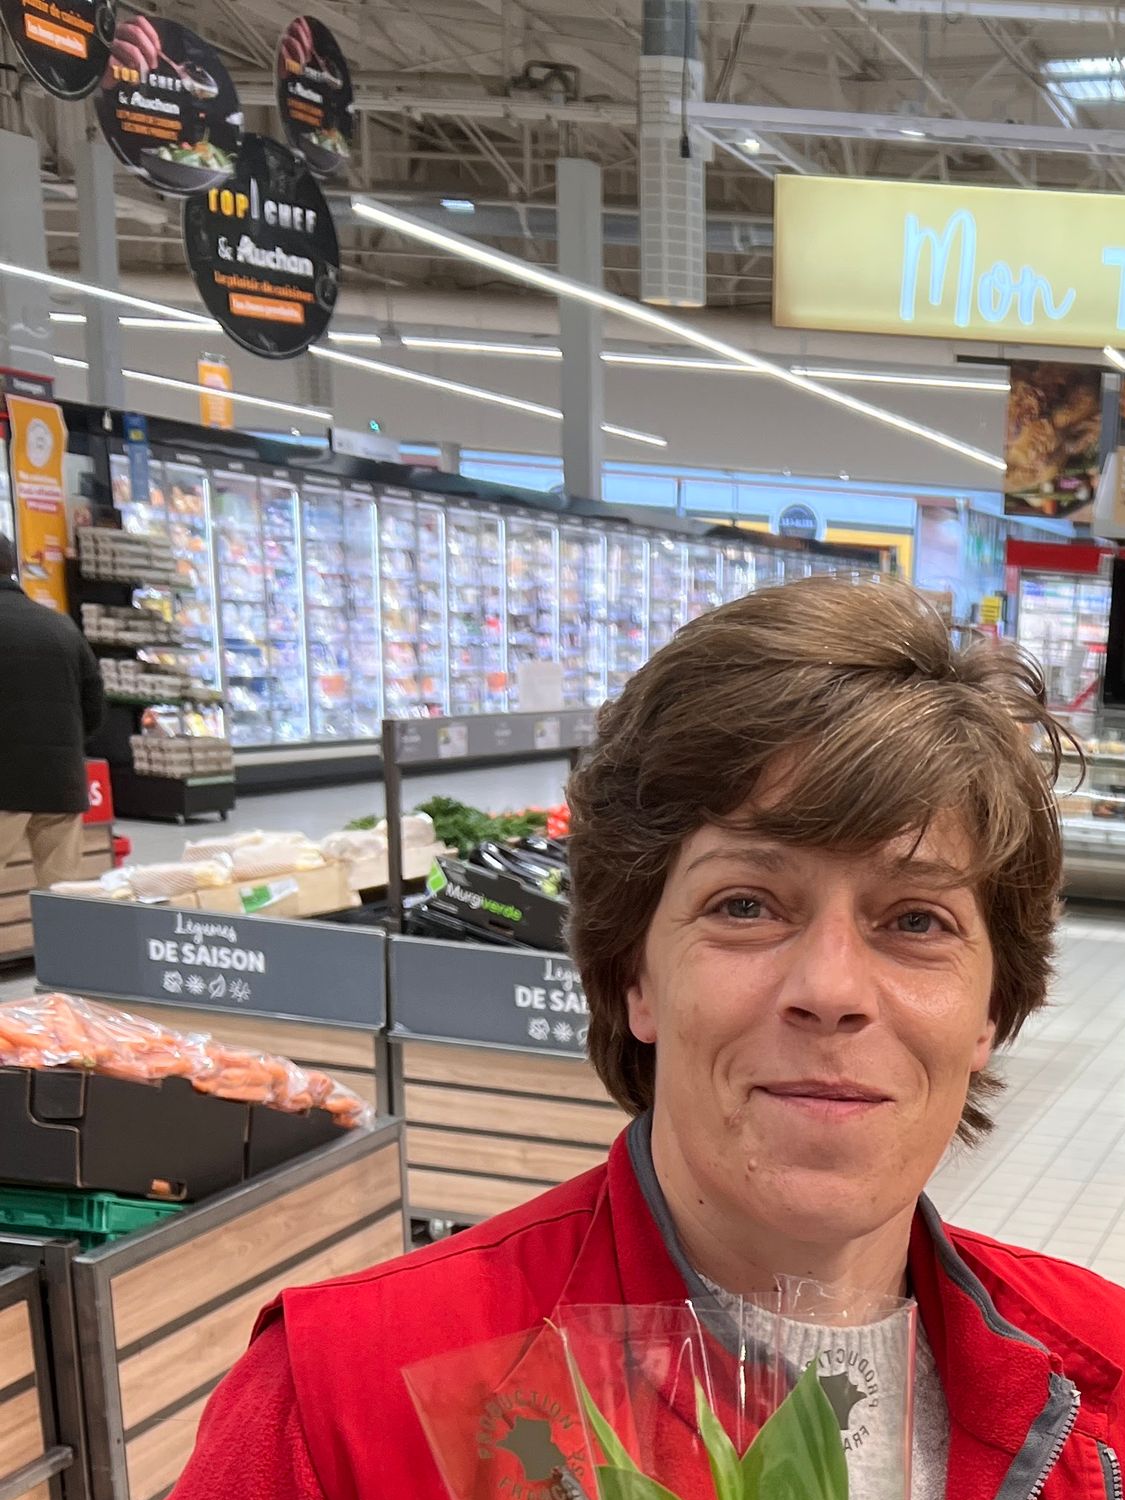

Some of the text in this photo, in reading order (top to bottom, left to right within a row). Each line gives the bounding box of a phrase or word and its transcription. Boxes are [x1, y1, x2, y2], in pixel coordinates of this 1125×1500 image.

[208, 187, 250, 219] TOP
[218, 234, 315, 278] & Auchan
[898, 208, 1077, 327] Mon
[446, 882, 523, 922] Murgiverde
[149, 938, 265, 974] DE SAISON
[514, 984, 547, 1010] DE
